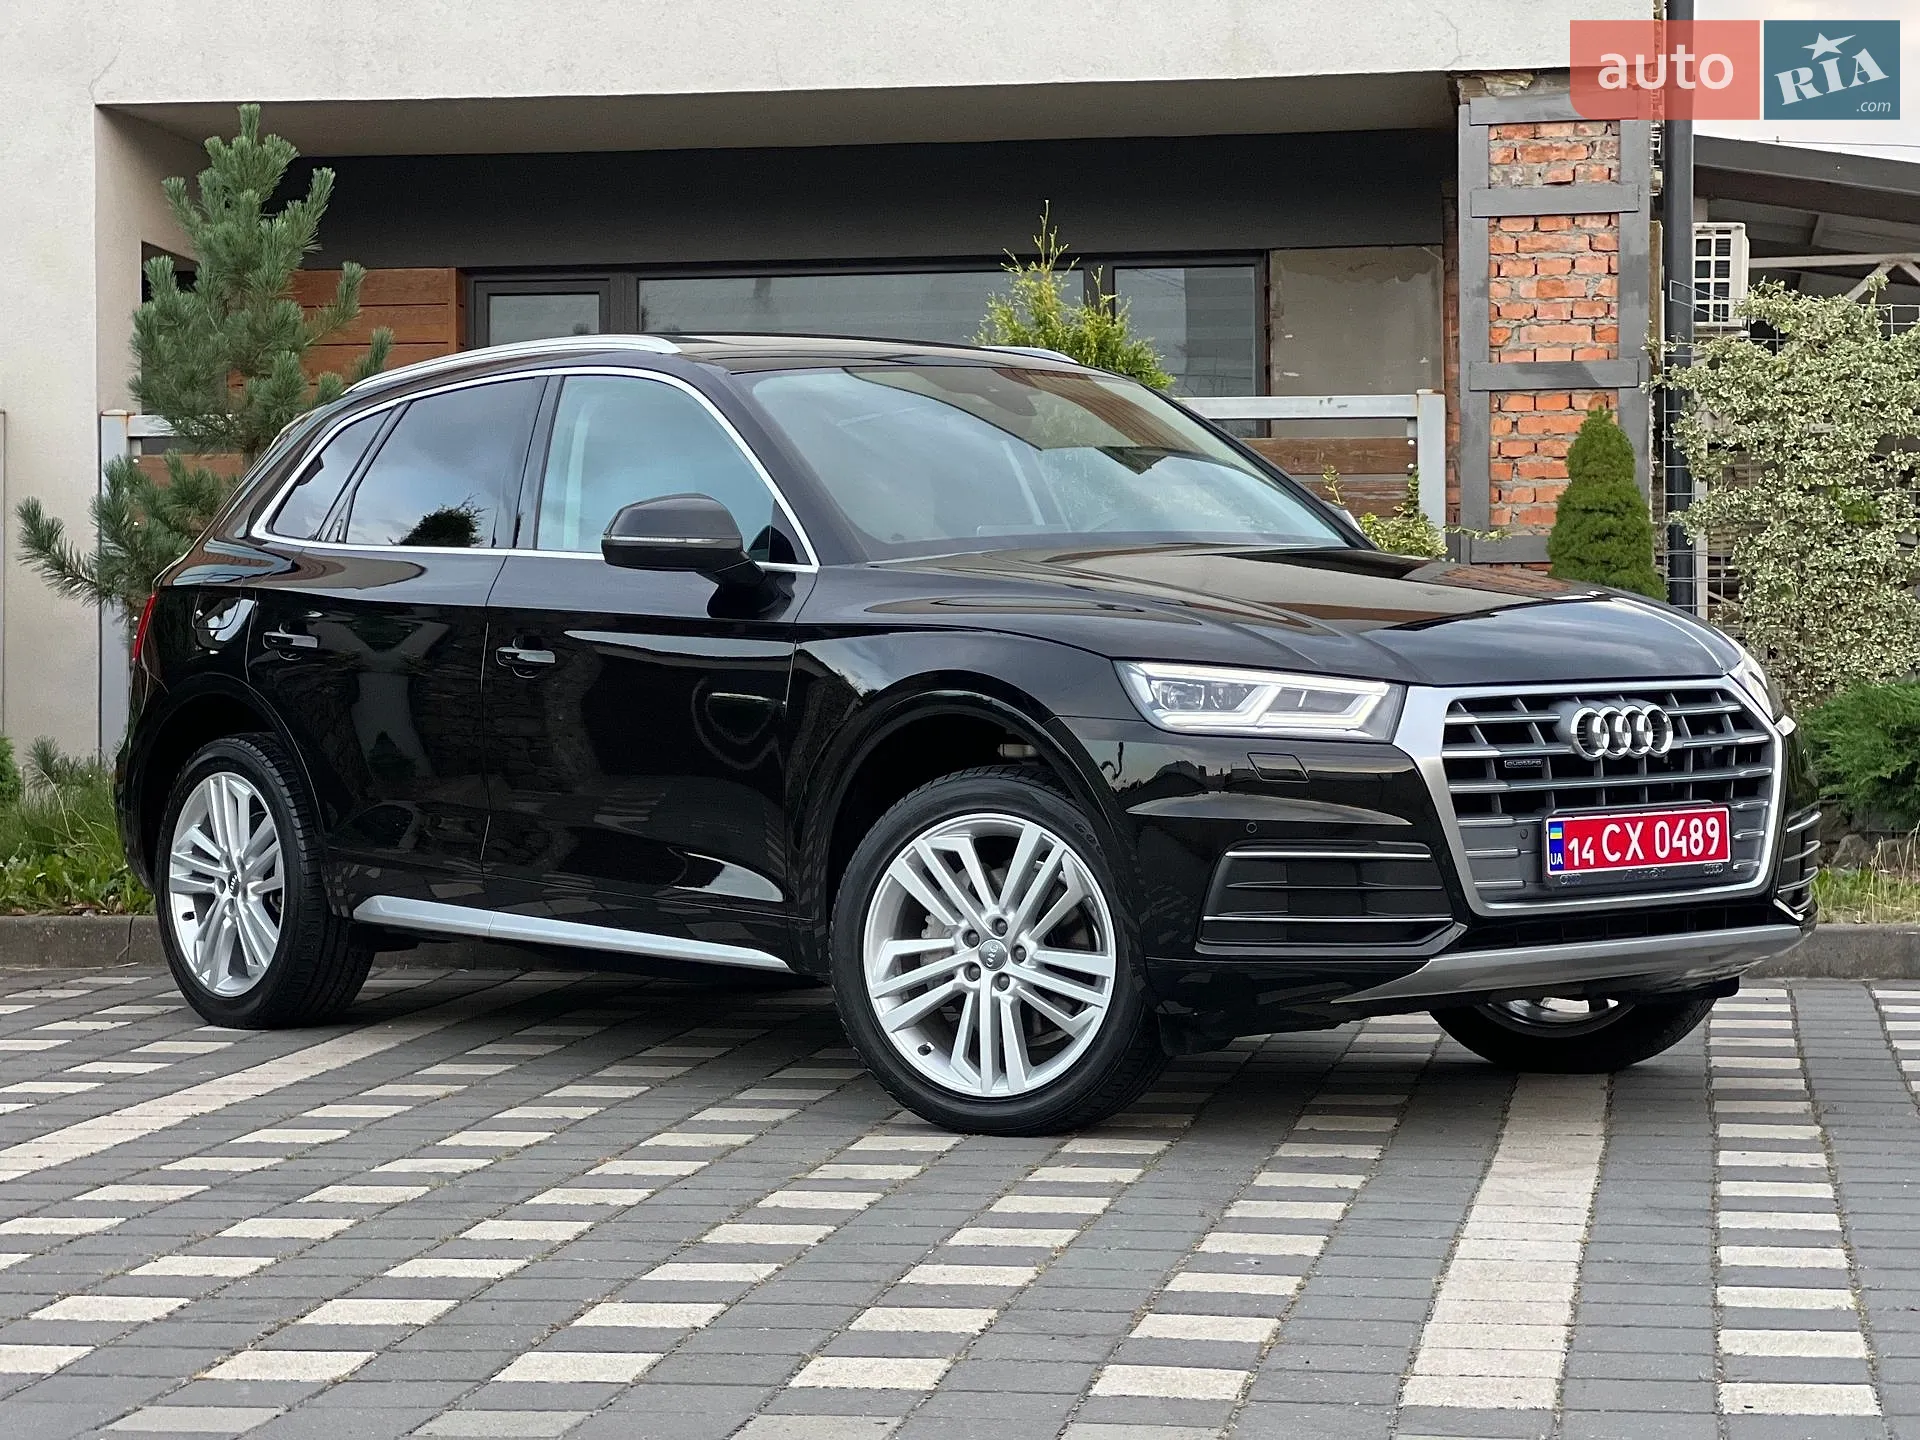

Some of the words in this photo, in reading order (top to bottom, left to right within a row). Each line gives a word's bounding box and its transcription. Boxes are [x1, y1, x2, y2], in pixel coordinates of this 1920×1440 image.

[1568, 836, 1595, 867] 14
[1602, 821, 1645, 862] CX
[1654, 816, 1720, 859] 0489
[1550, 852, 1563, 865] UA
